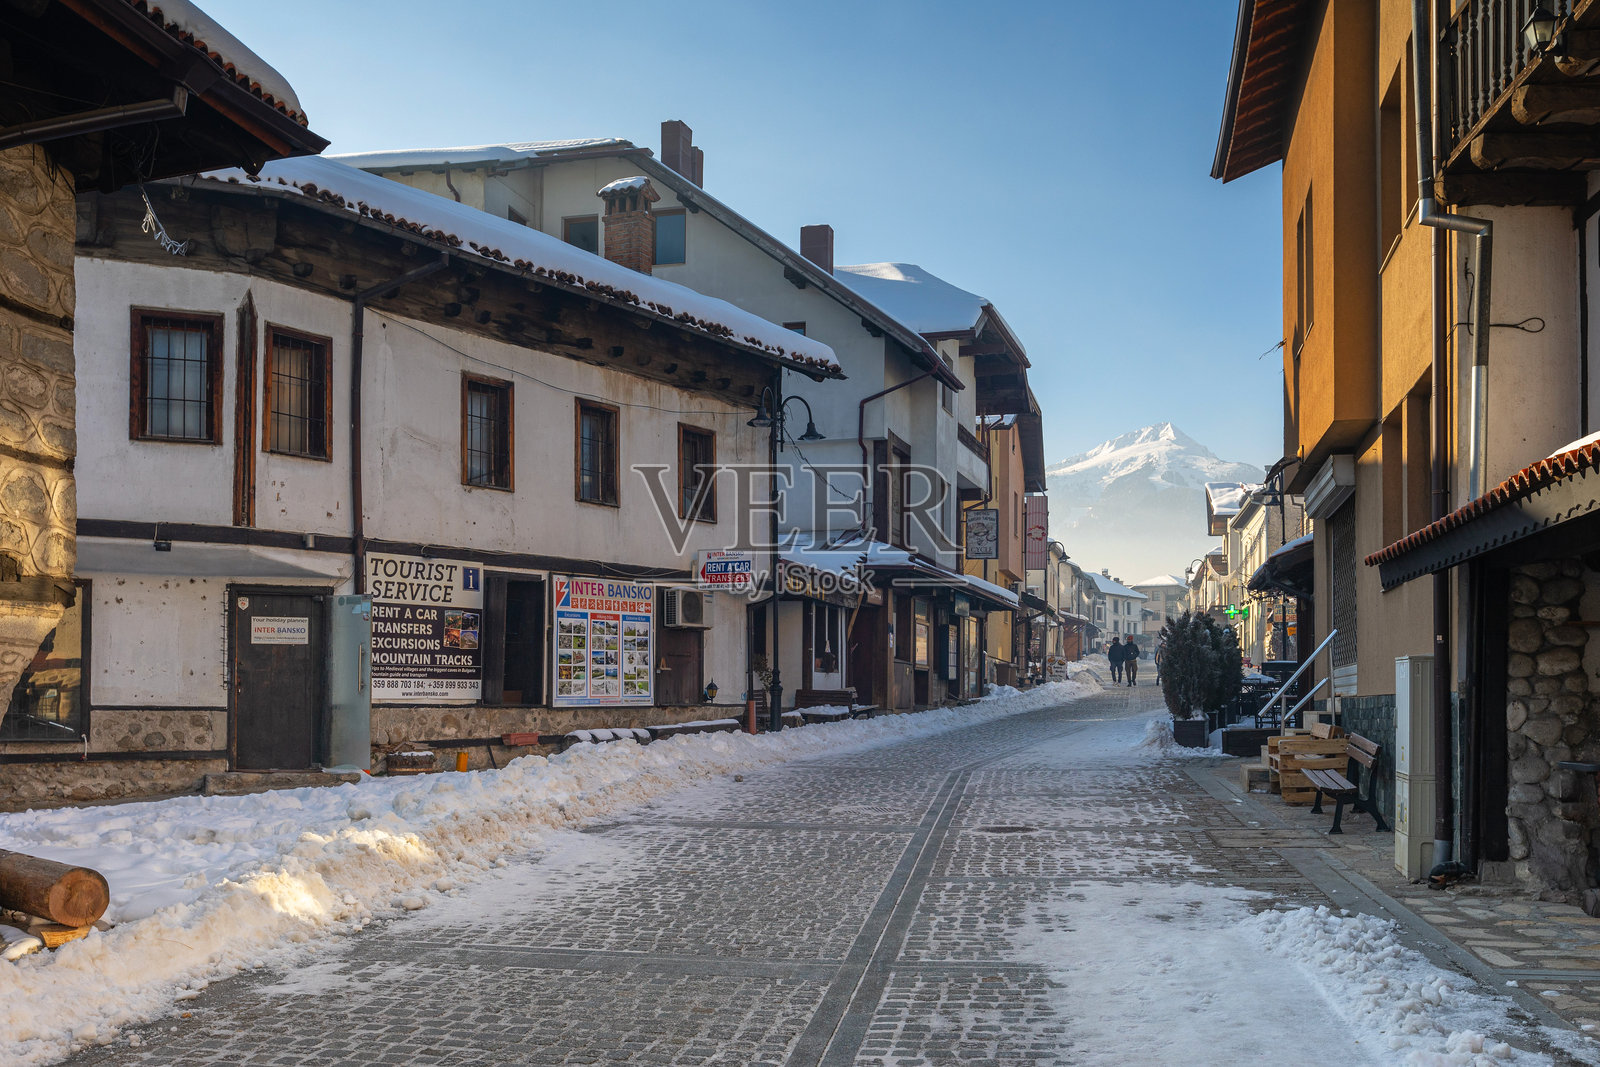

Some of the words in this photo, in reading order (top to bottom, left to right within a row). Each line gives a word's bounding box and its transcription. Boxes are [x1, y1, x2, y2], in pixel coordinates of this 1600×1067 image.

[370, 558, 457, 582] TOURIST
[707, 563, 725, 572] RENT
[727, 562, 732, 572] A
[735, 562, 750, 571] CAR
[708, 573, 750, 583] TRANSFERS
[371, 580, 453, 603] SERVICE
[571, 581, 604, 596] INTER
[608, 584, 652, 600] BANSKO
[372, 606, 400, 618] RENT
[404, 608, 412, 618] A
[416, 609, 438, 620] CAR
[372, 622, 432, 635] TRANSFERS
[372, 638, 440, 650] EXCURSIONS
[371, 652, 430, 664] MOUNTAIN
[435, 654, 472, 666] TRACKS
[387, 680, 398, 688] 888
[400, 680, 412, 688] 703
[413, 680, 426, 689] 184;
[428, 680, 443, 689] +359
[445, 681, 456, 689] 899
[457, 681, 467, 689] 933
[468, 681, 479, 689] 343
